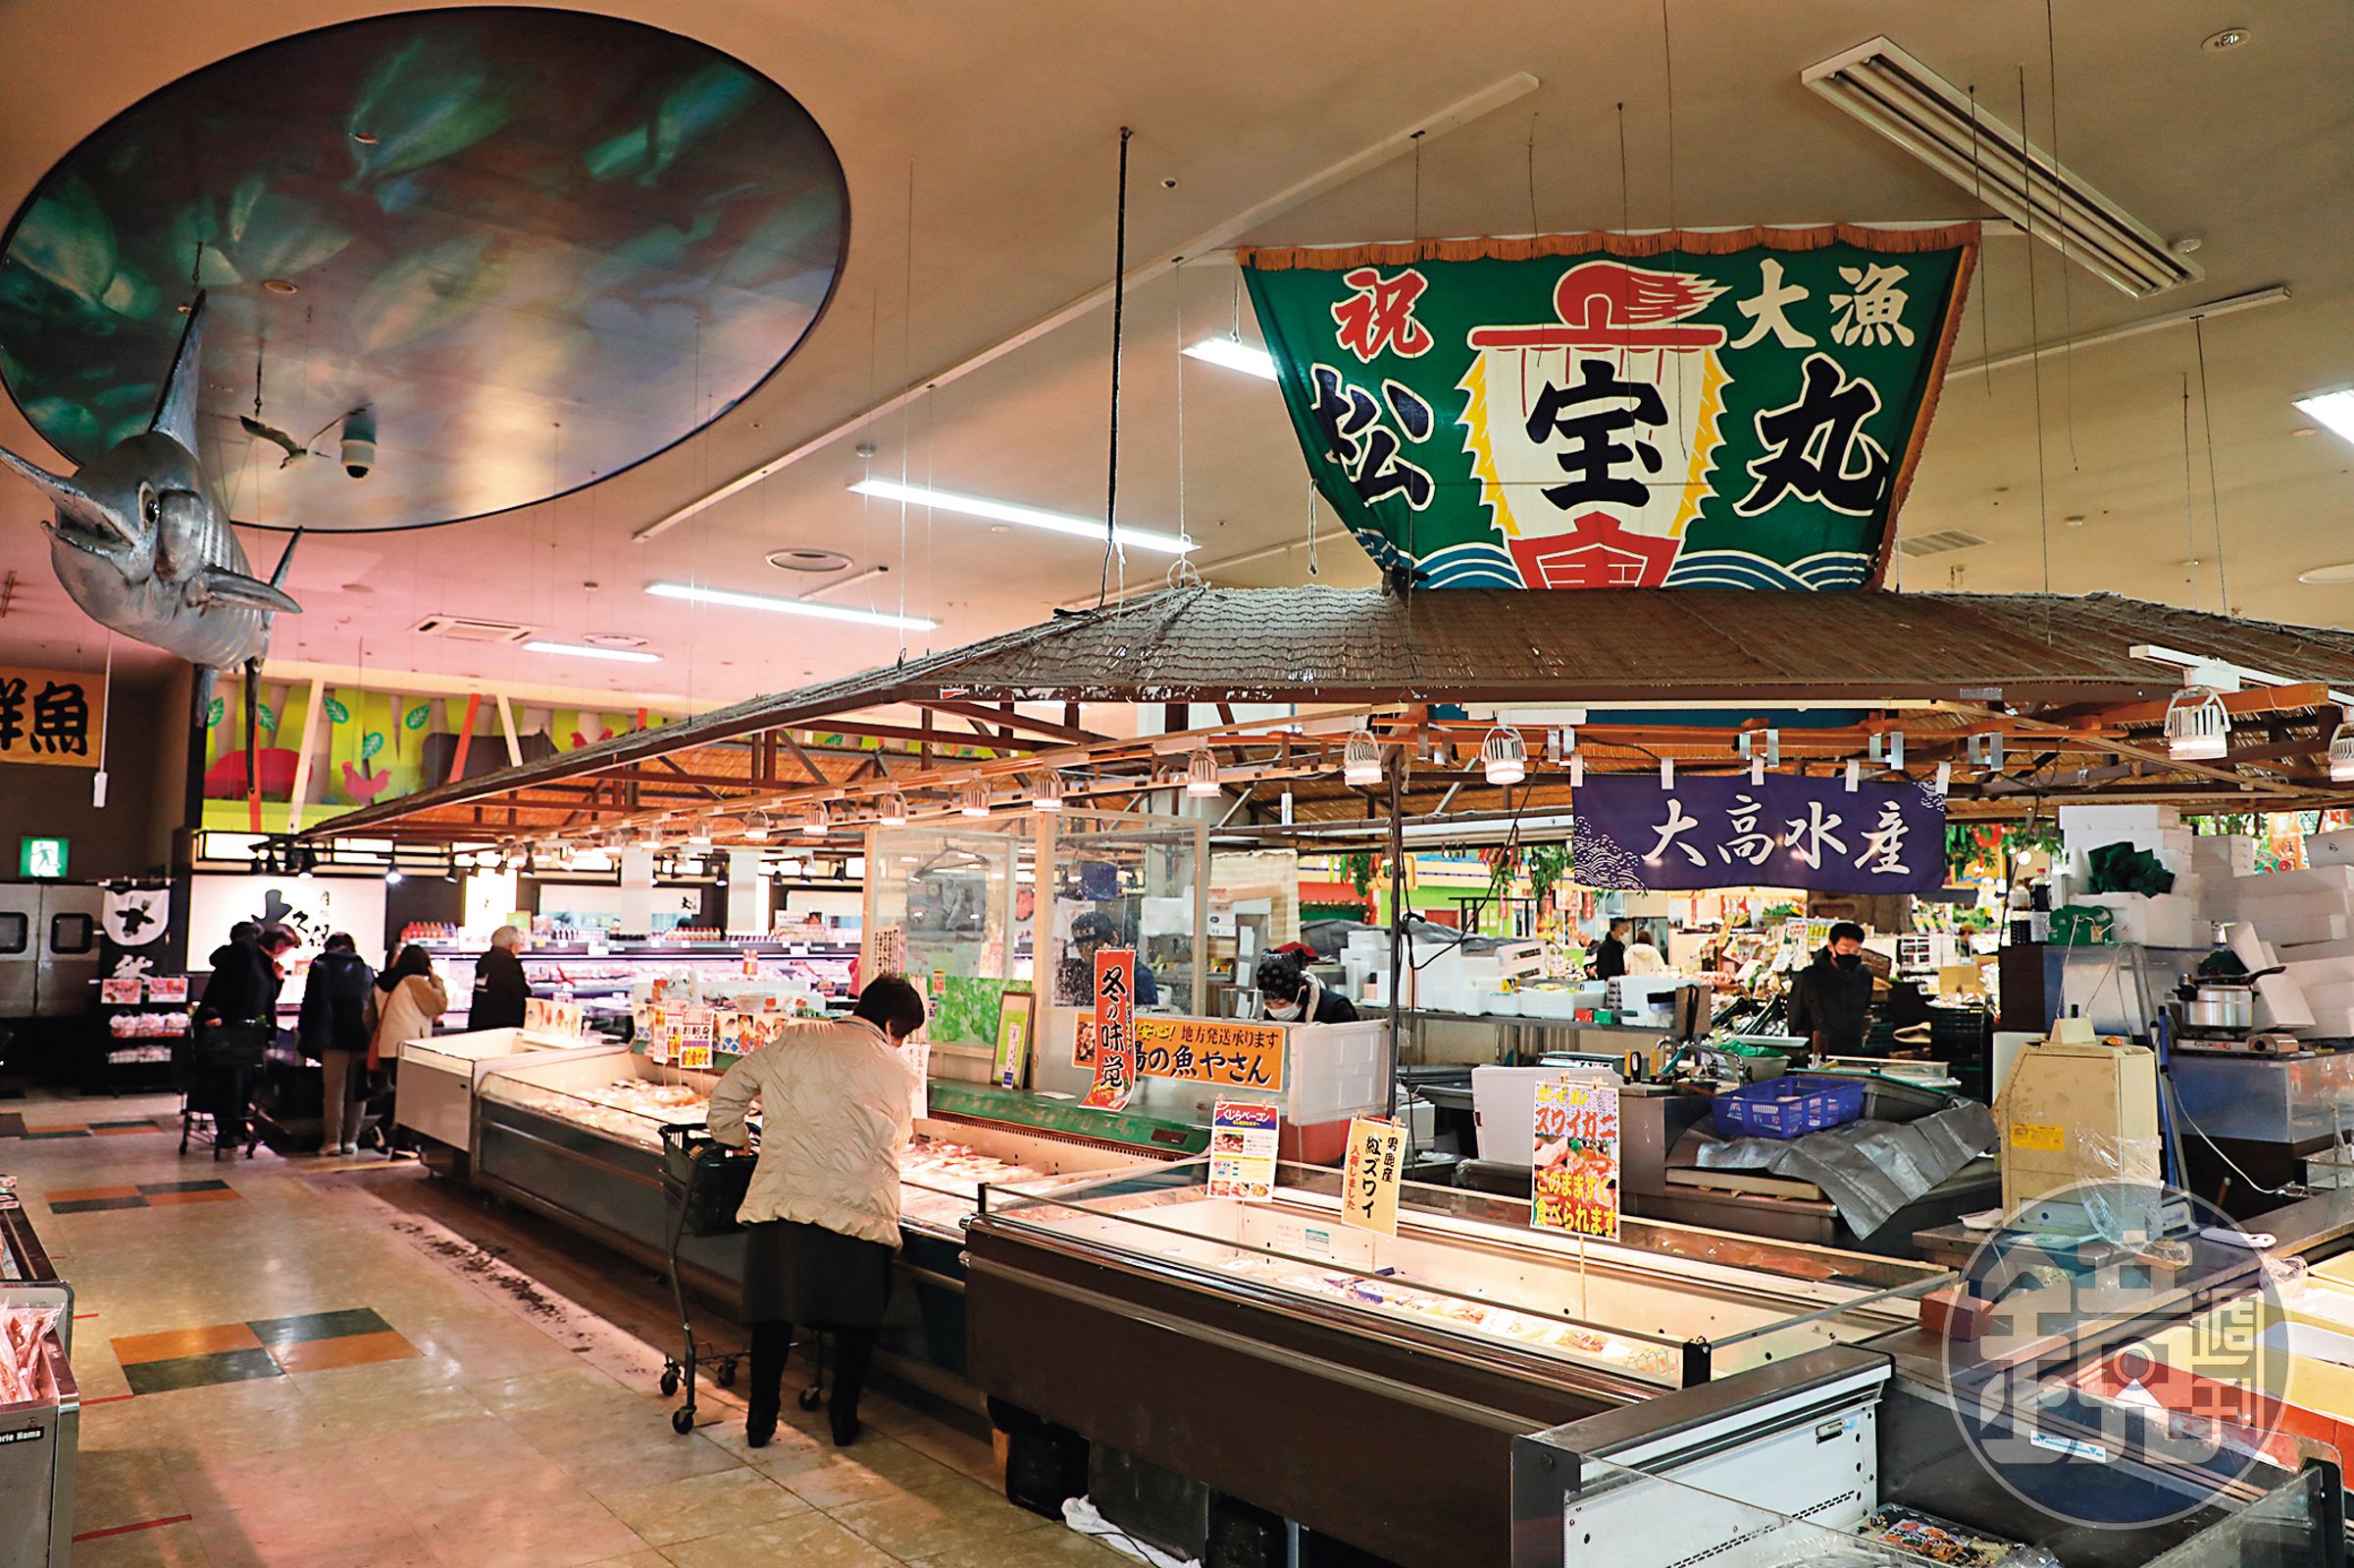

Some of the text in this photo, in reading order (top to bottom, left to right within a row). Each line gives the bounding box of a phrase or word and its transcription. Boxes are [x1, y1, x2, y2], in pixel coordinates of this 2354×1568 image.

[1331, 258, 1916, 364] 祝 大漁
[1641, 793, 1912, 875] 大高水産
[1100, 966, 1127, 1088] 冬の味覚
[1181, 1025, 1279, 1049] 地方発送承ります
[1346, 1144, 1361, 1211] 入荷しました
[1381, 1138, 1399, 1184] 男鹿産
[1534, 1196, 1616, 1238] 食べられます
